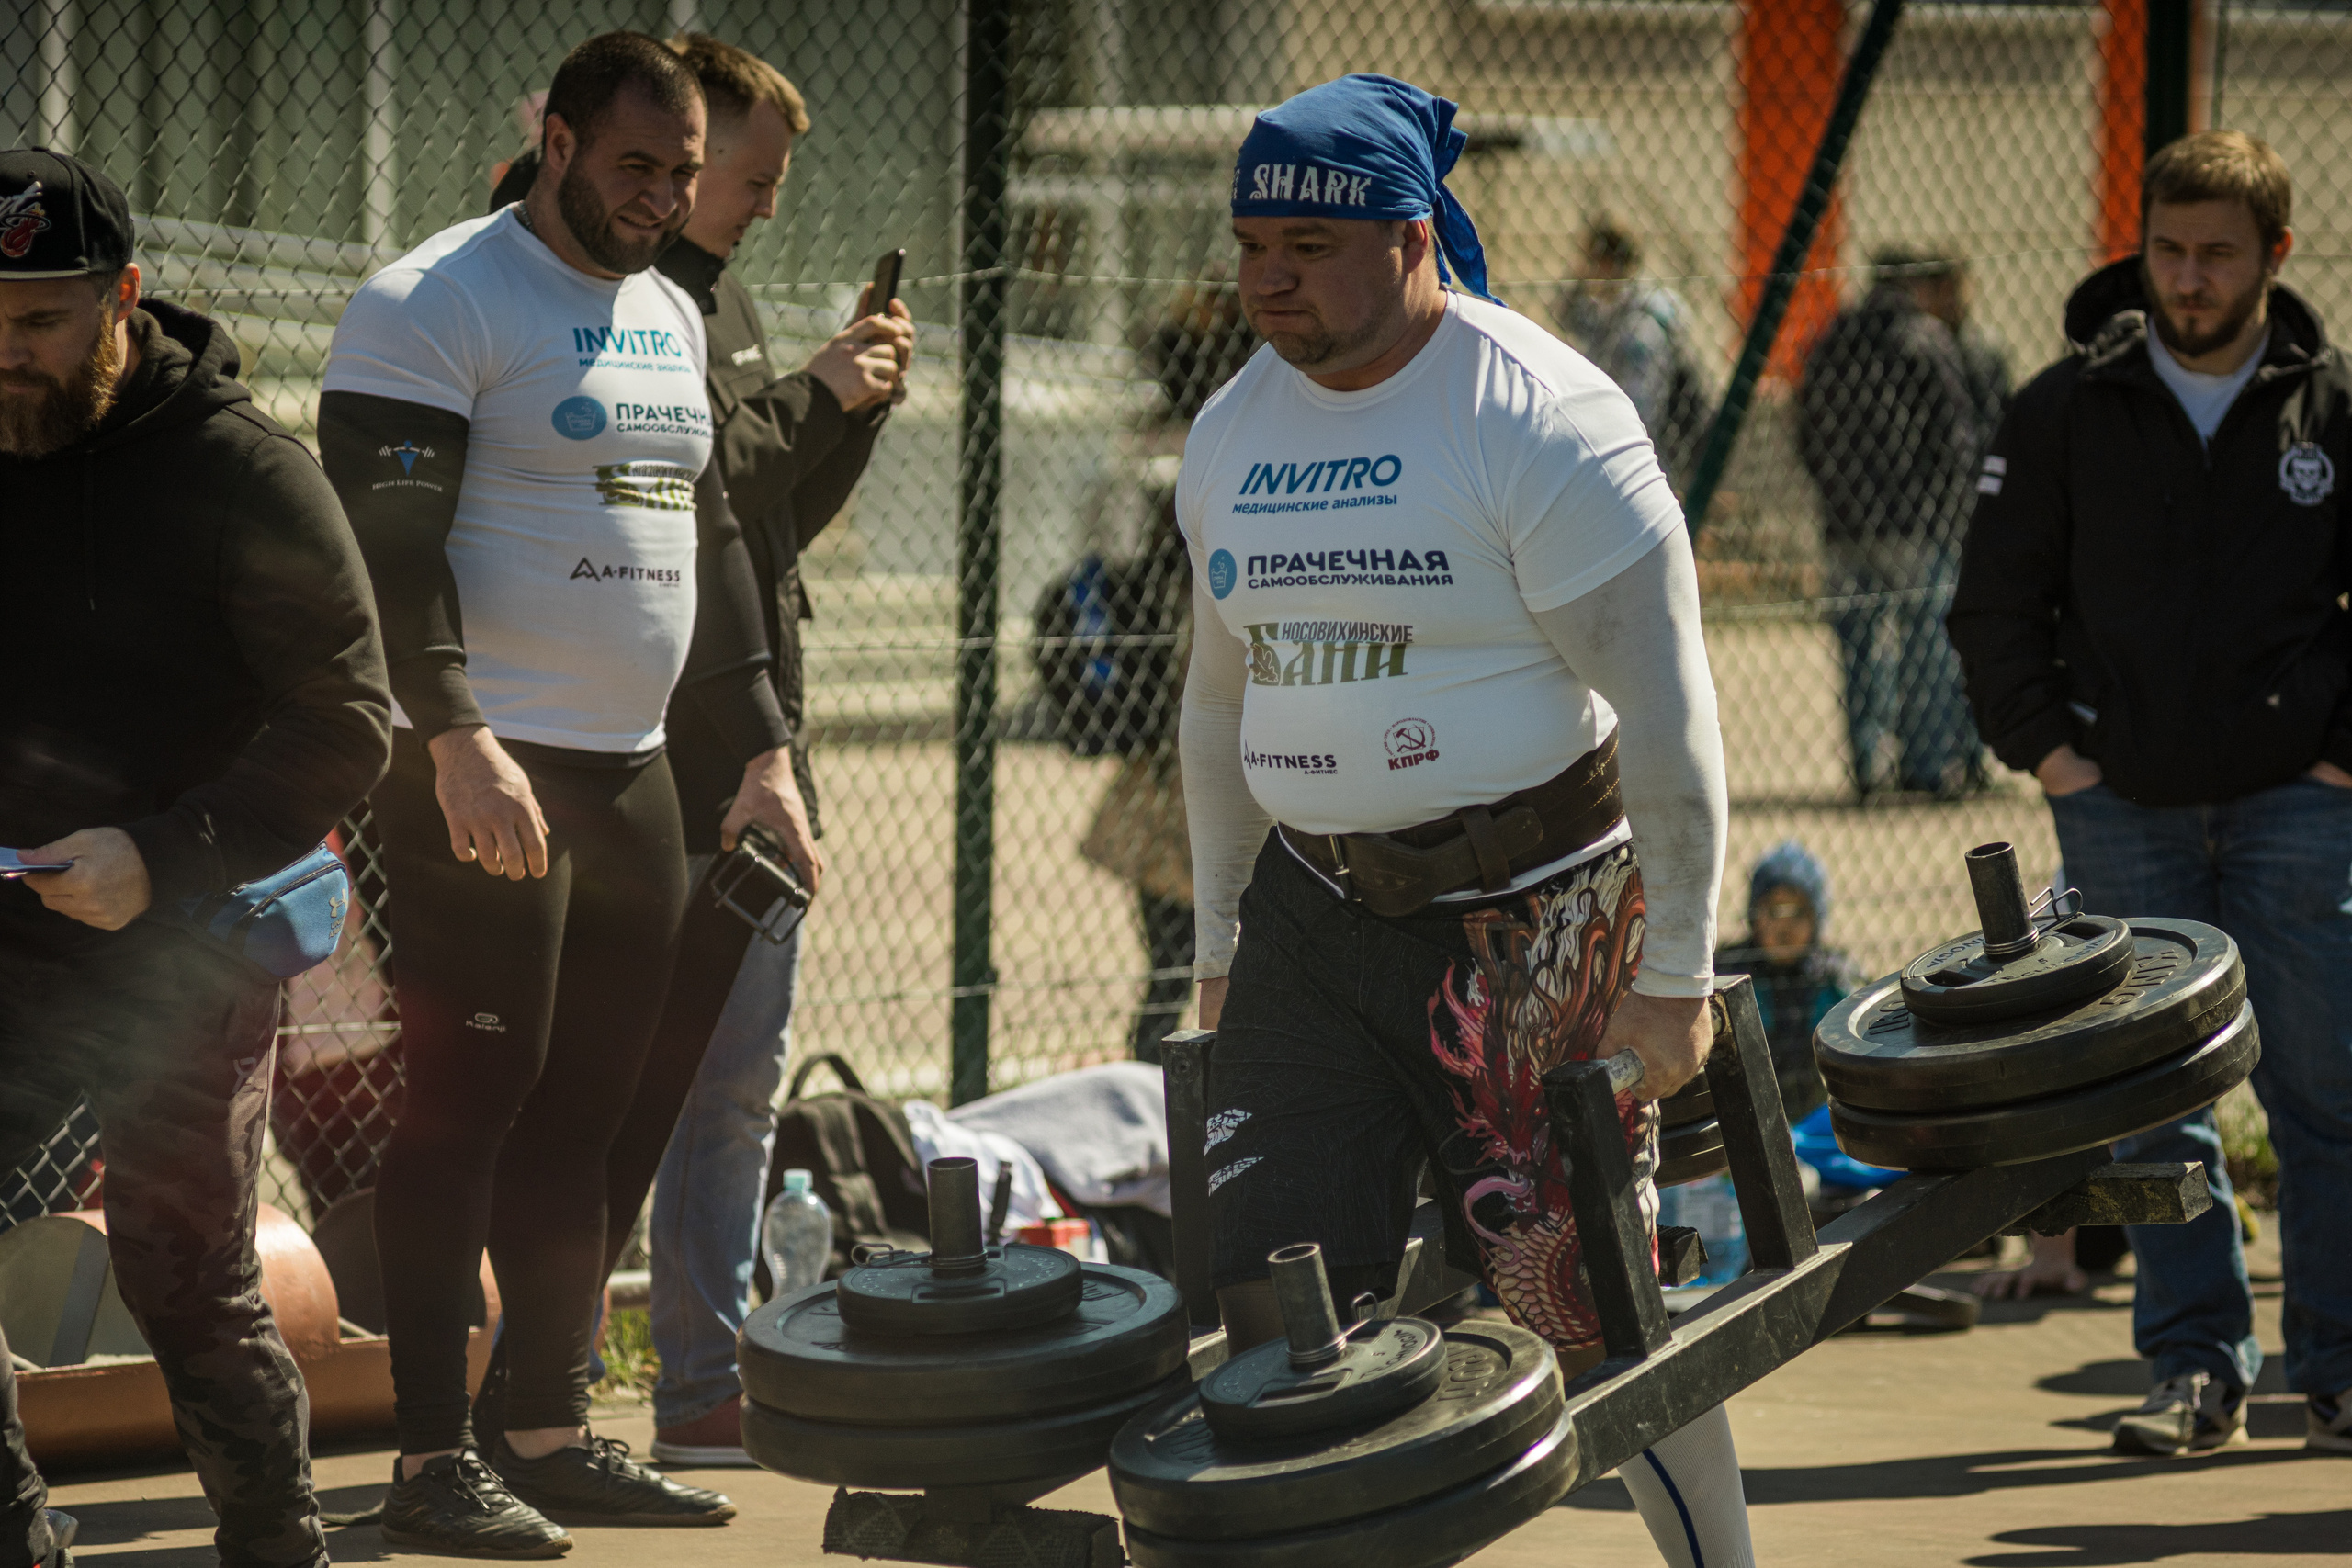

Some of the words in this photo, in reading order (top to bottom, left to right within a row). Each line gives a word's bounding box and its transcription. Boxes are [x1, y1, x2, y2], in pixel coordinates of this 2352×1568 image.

[1250, 164, 1372, 206] SHARK
[572, 326, 682, 357] INVITRO
[1238, 454, 1402, 495] INVITRO
[1232, 499, 1329, 515] медицинские
[1331, 494, 1397, 510] анализы
[1247, 548, 1450, 577] ПРАЧЕЧНАЯ
[1248, 573, 1453, 590] САМООБСЛУЖИВАНИЯ
[1282, 620, 1414, 643] НОСОВИХИНСКИЕ
[1243, 622, 1414, 687] БАНИ
[1387, 749, 1440, 771] КПРФ
